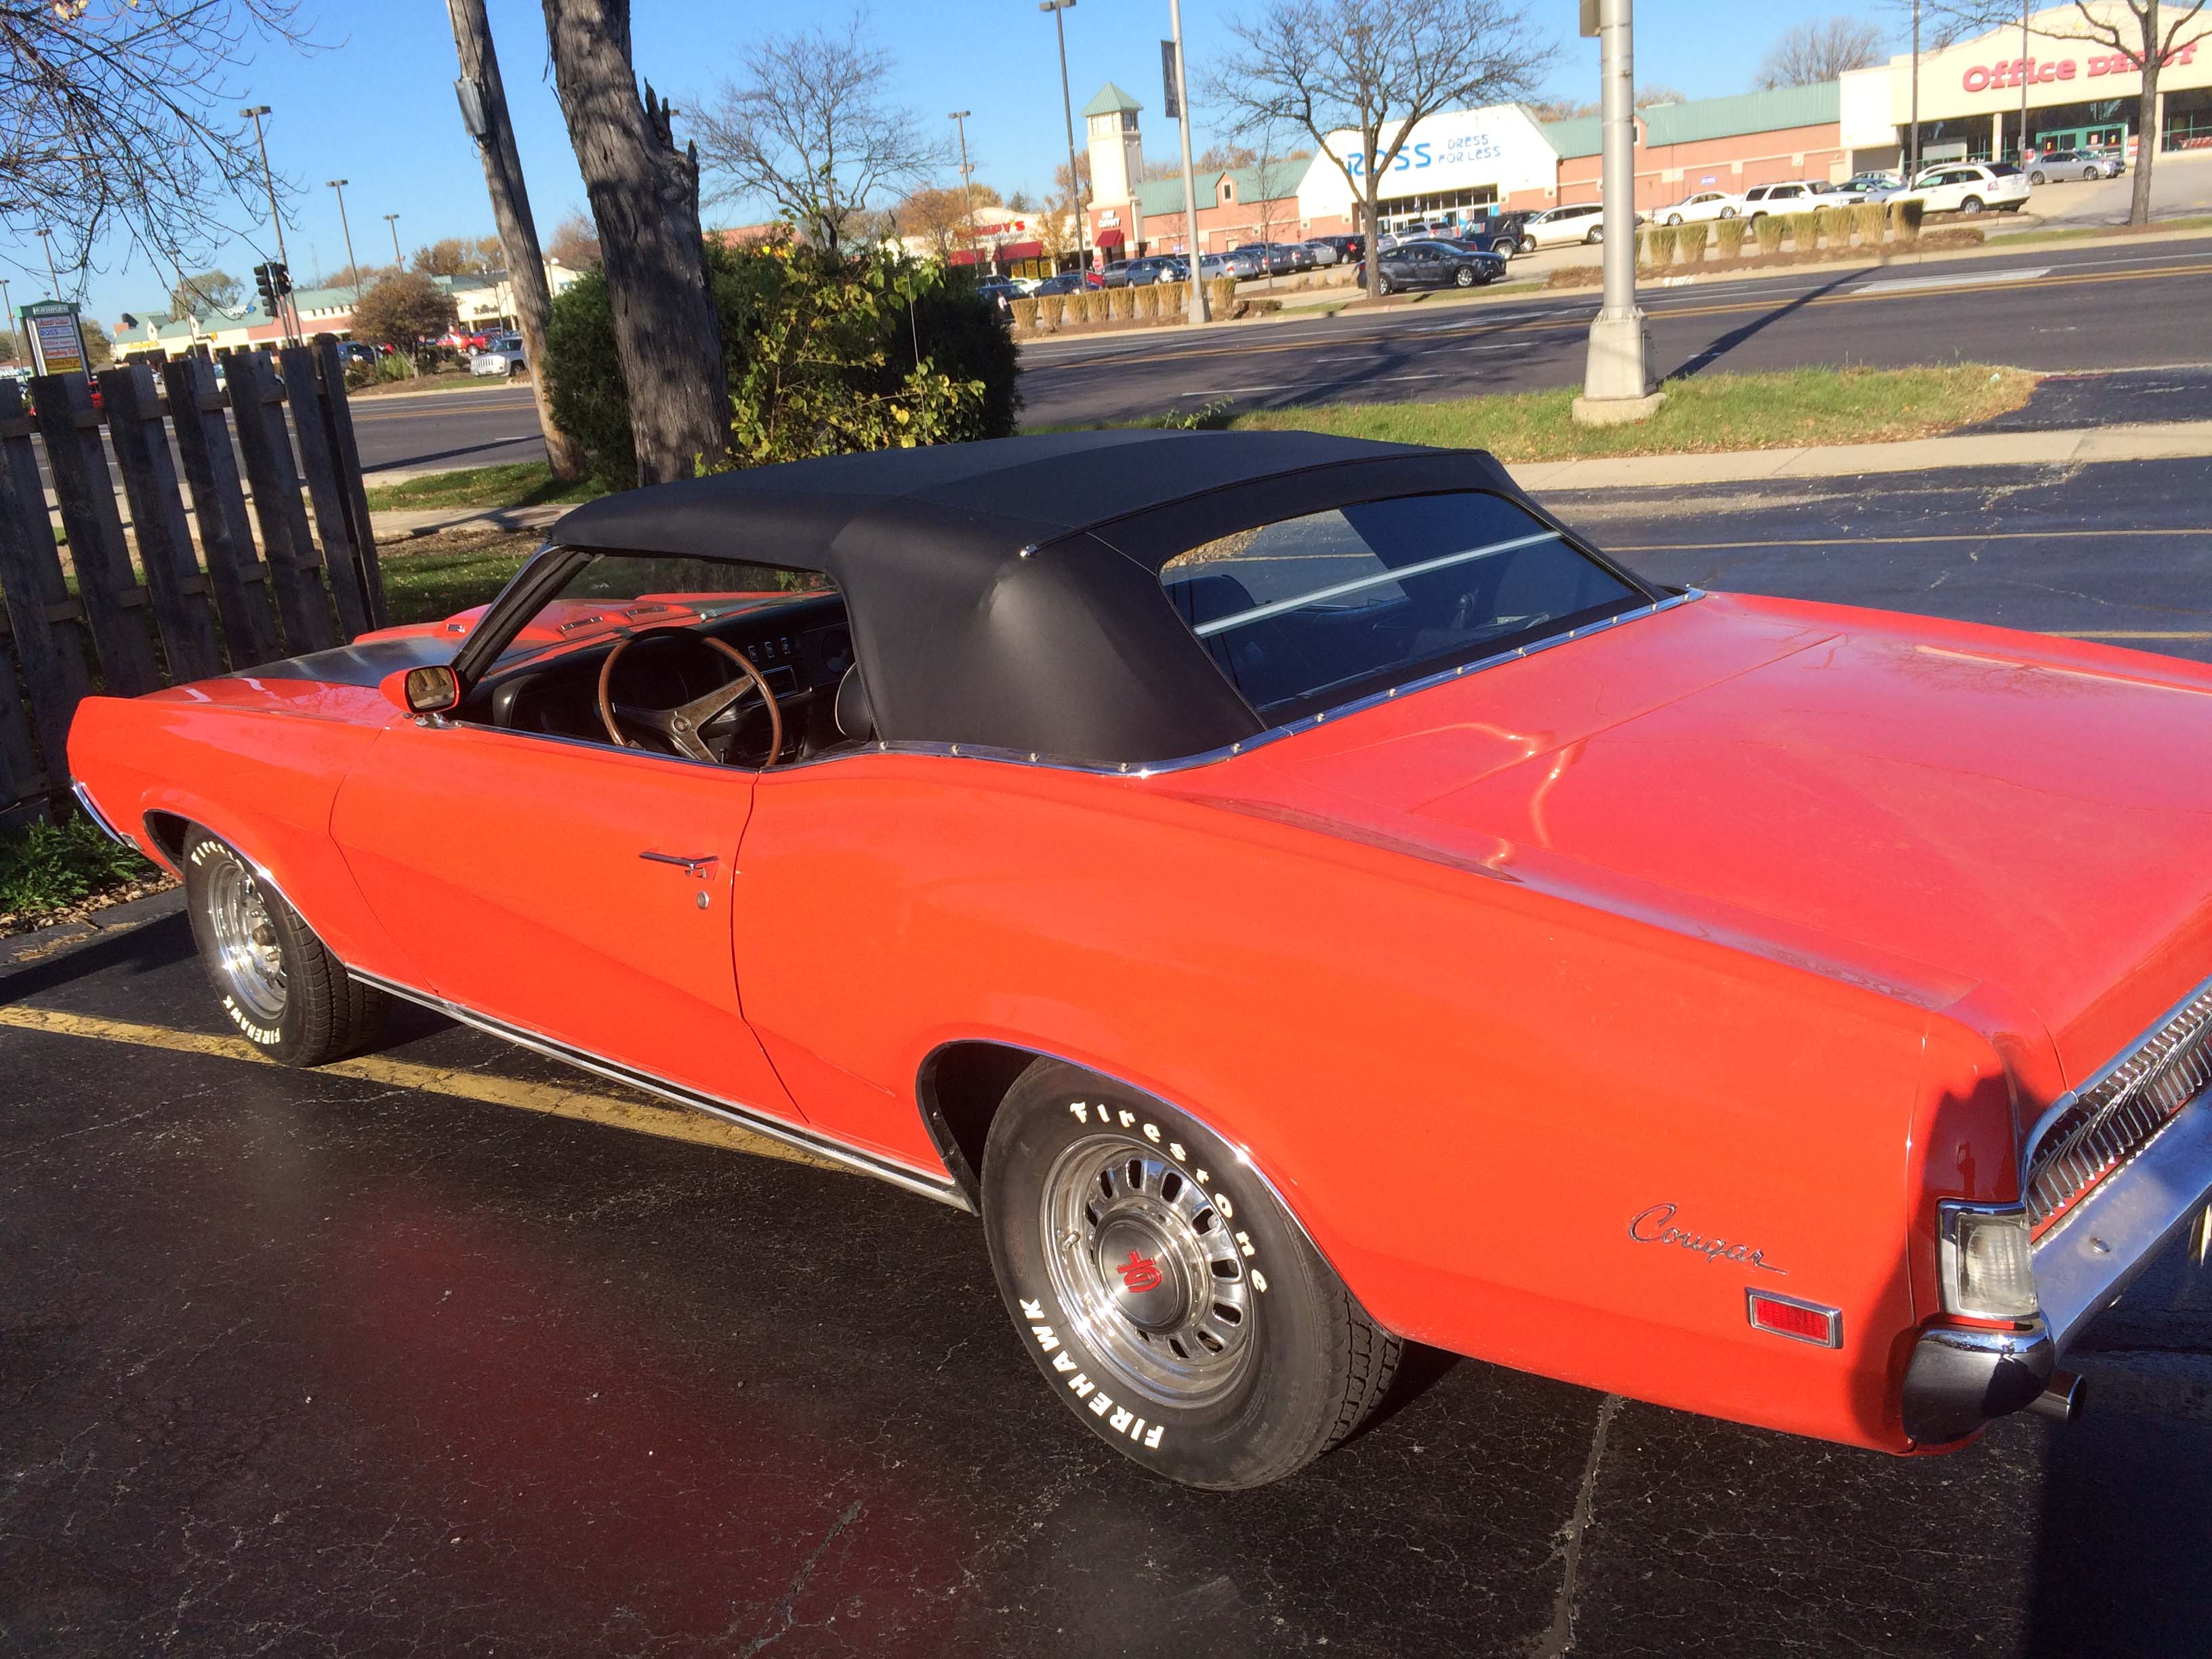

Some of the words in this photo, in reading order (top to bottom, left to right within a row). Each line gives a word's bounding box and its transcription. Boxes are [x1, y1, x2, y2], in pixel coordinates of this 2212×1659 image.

[1963, 57, 2076, 92] Office
[1438, 152, 1463, 164] FOR
[1468, 146, 1501, 161] LESS
[1448, 134, 1489, 150] DRESS
[223, 995, 281, 1044] FIREHAWK
[1069, 1101, 1268, 1293] Firestone
[1629, 1203, 1788, 1275] Cougar
[1019, 1298, 1164, 1449] FIREHAWK
